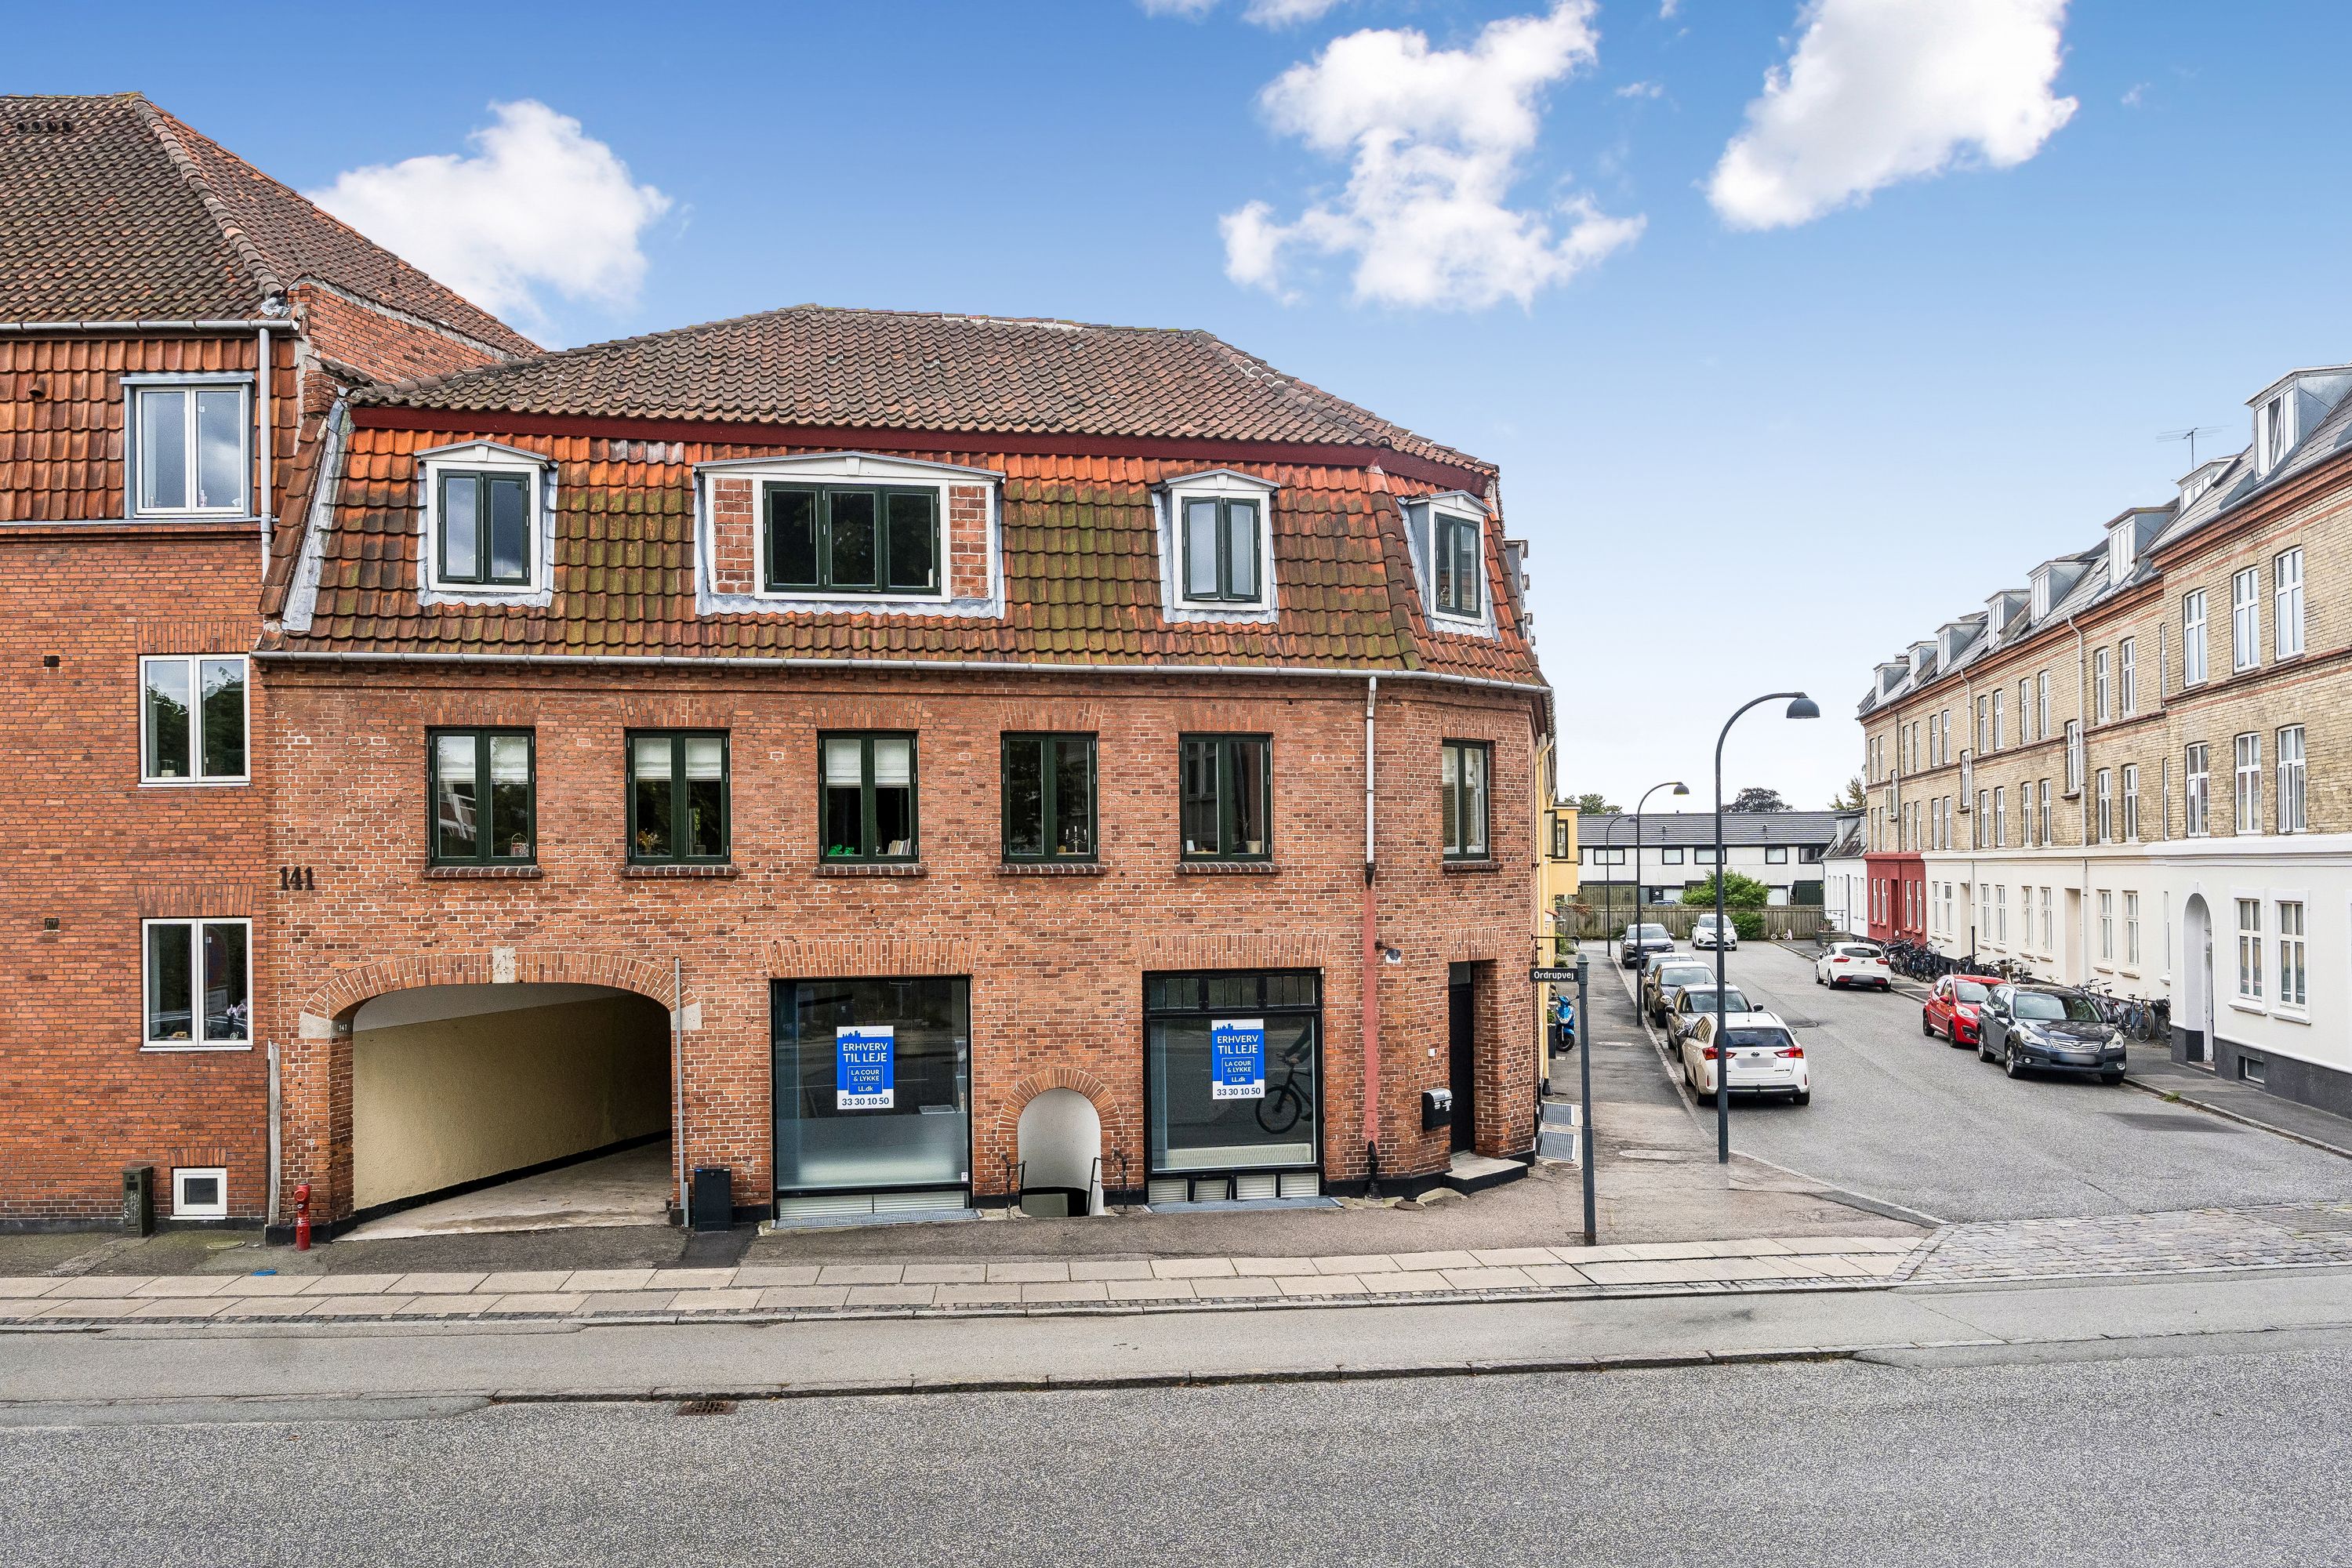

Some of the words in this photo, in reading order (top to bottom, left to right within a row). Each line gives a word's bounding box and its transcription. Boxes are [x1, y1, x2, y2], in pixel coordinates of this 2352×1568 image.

[280, 866, 315, 891] 141
[1534, 971, 1574, 980] Ordrupvej
[339, 1023, 347, 1032] 141
[1217, 1035, 1259, 1044] ERHVERV
[843, 1043, 888, 1051] ERHVERV
[1218, 1045, 1234, 1054] TIL
[1236, 1044, 1258, 1054] LEJE
[843, 1053, 861, 1062] TIL
[862, 1053, 887, 1062] LEJE
